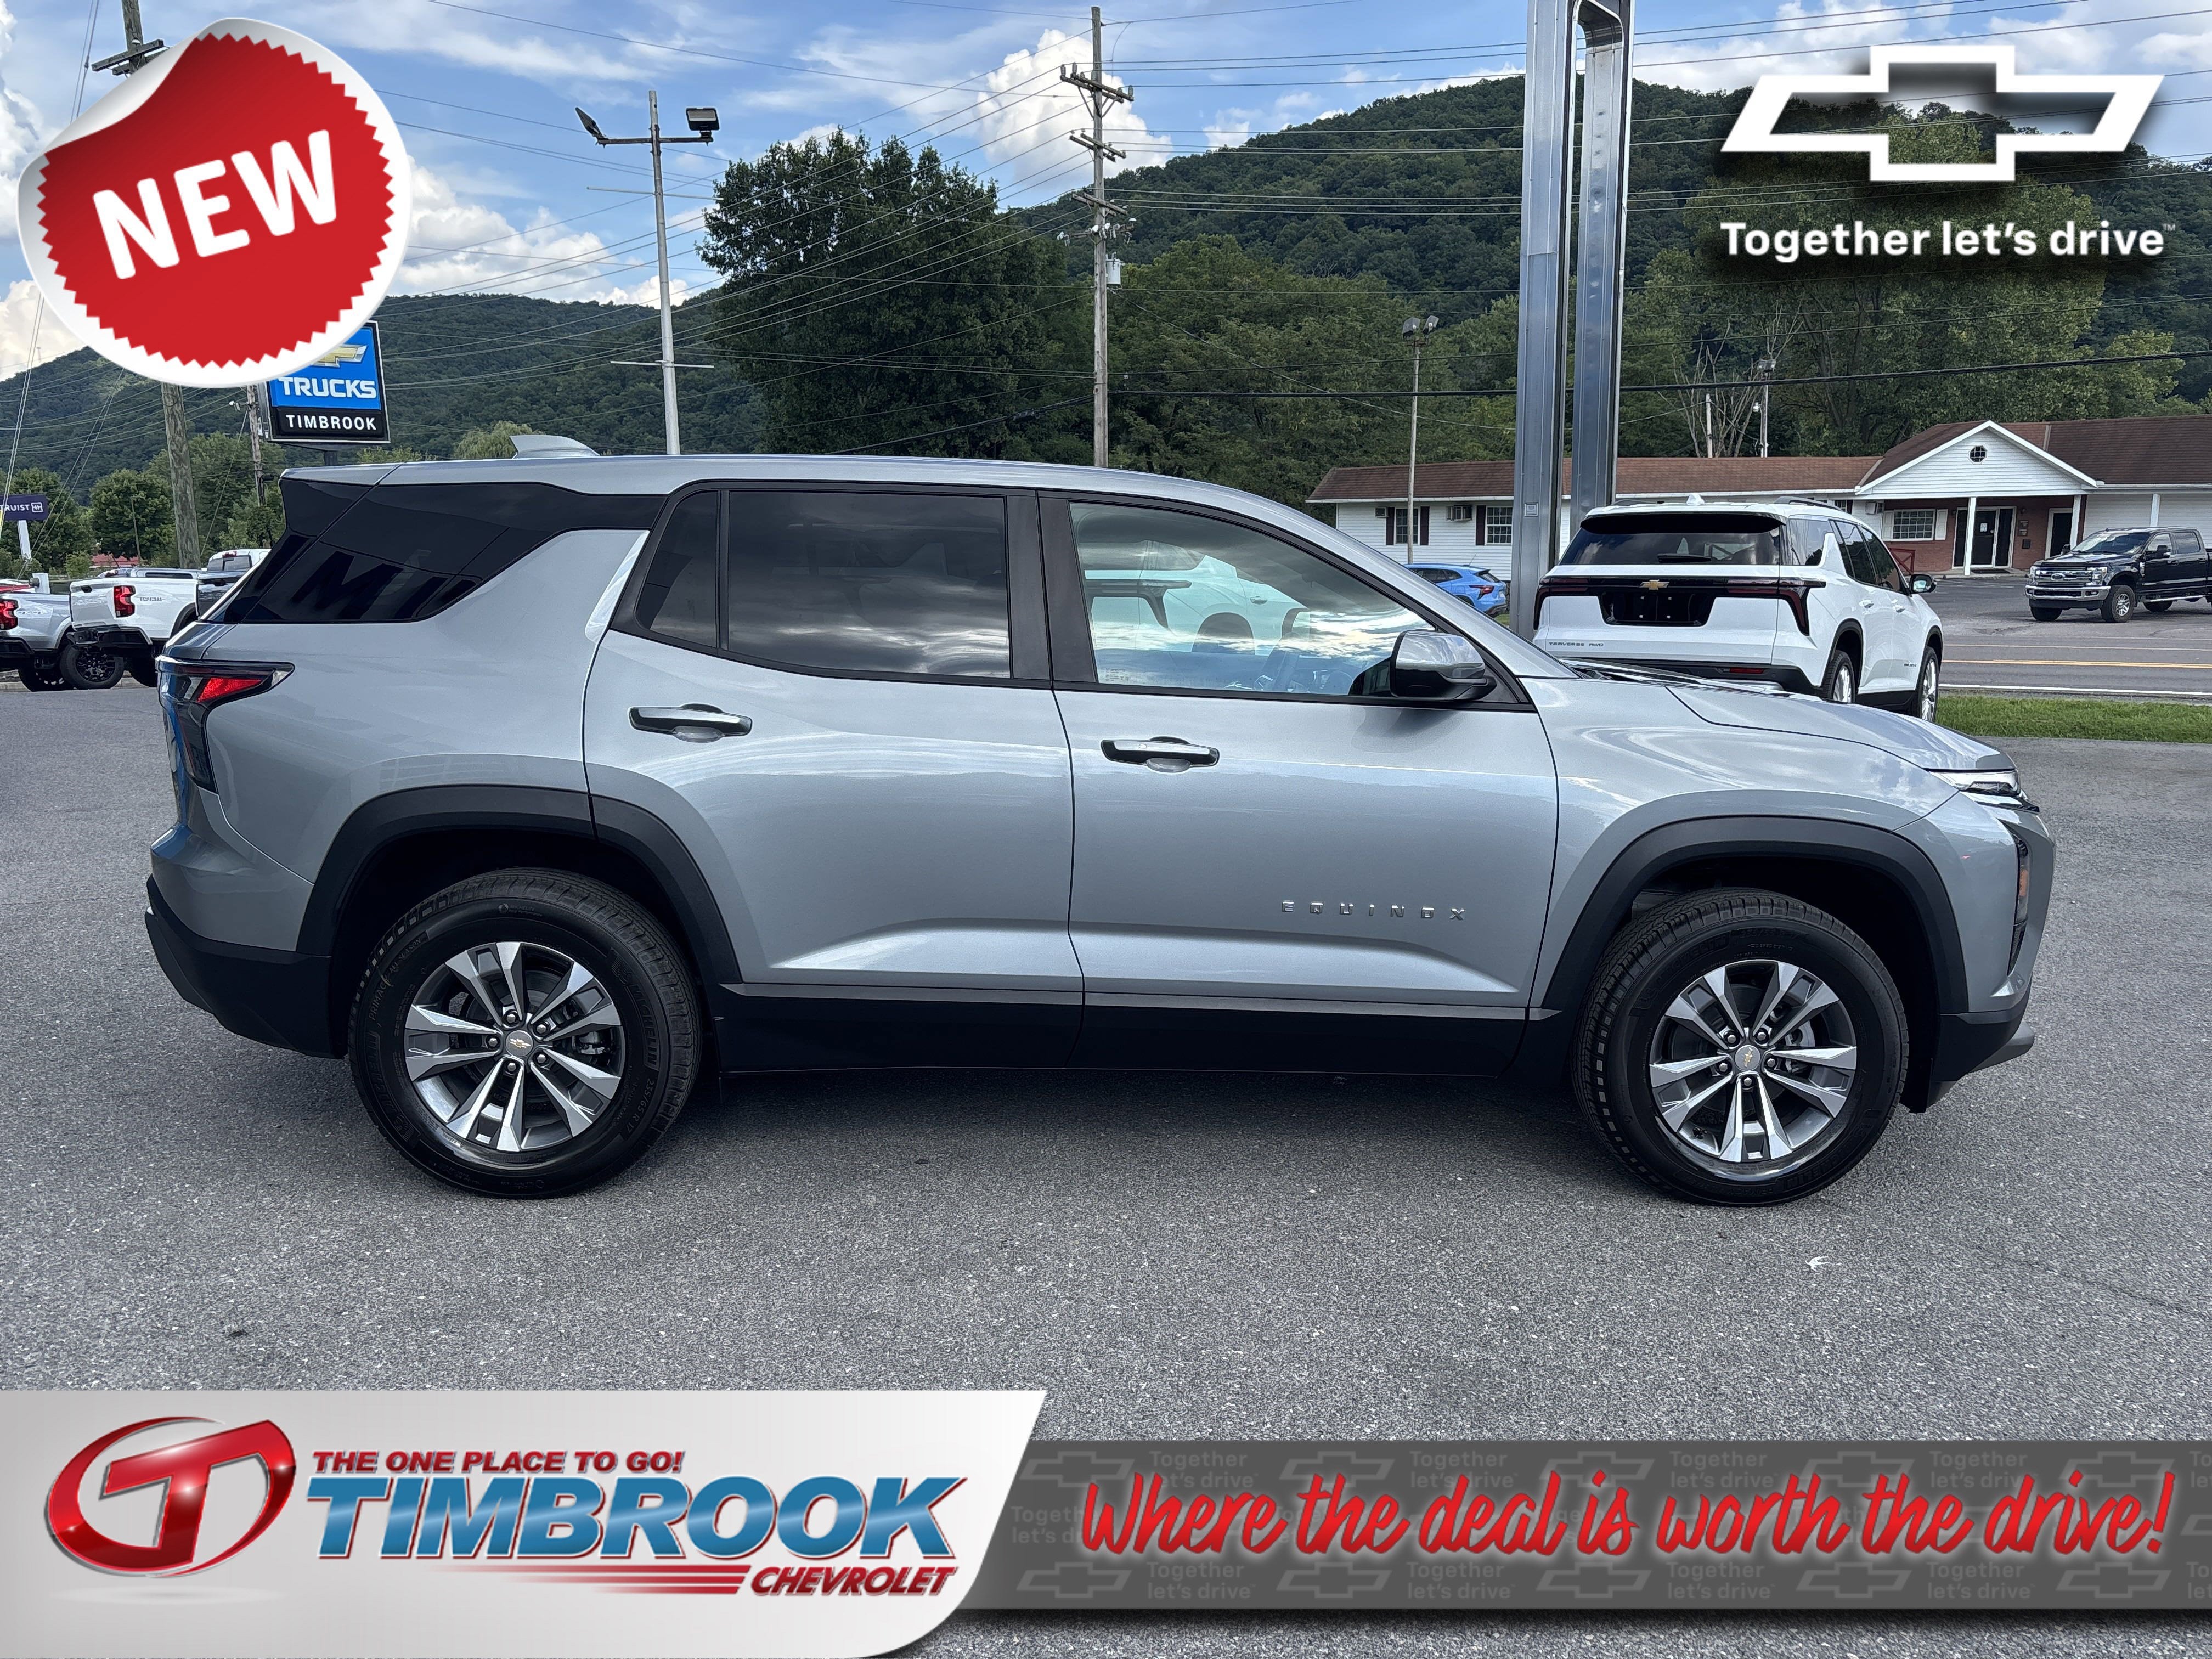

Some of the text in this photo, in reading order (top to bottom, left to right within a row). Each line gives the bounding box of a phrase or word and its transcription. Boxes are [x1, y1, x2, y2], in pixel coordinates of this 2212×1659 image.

[278, 377, 377, 399] TRUCKS
[286, 415, 377, 430] TIMBROOK
[1281, 900, 1466, 921] EQUINOX
[637, 1078, 654, 1113] 235/65
